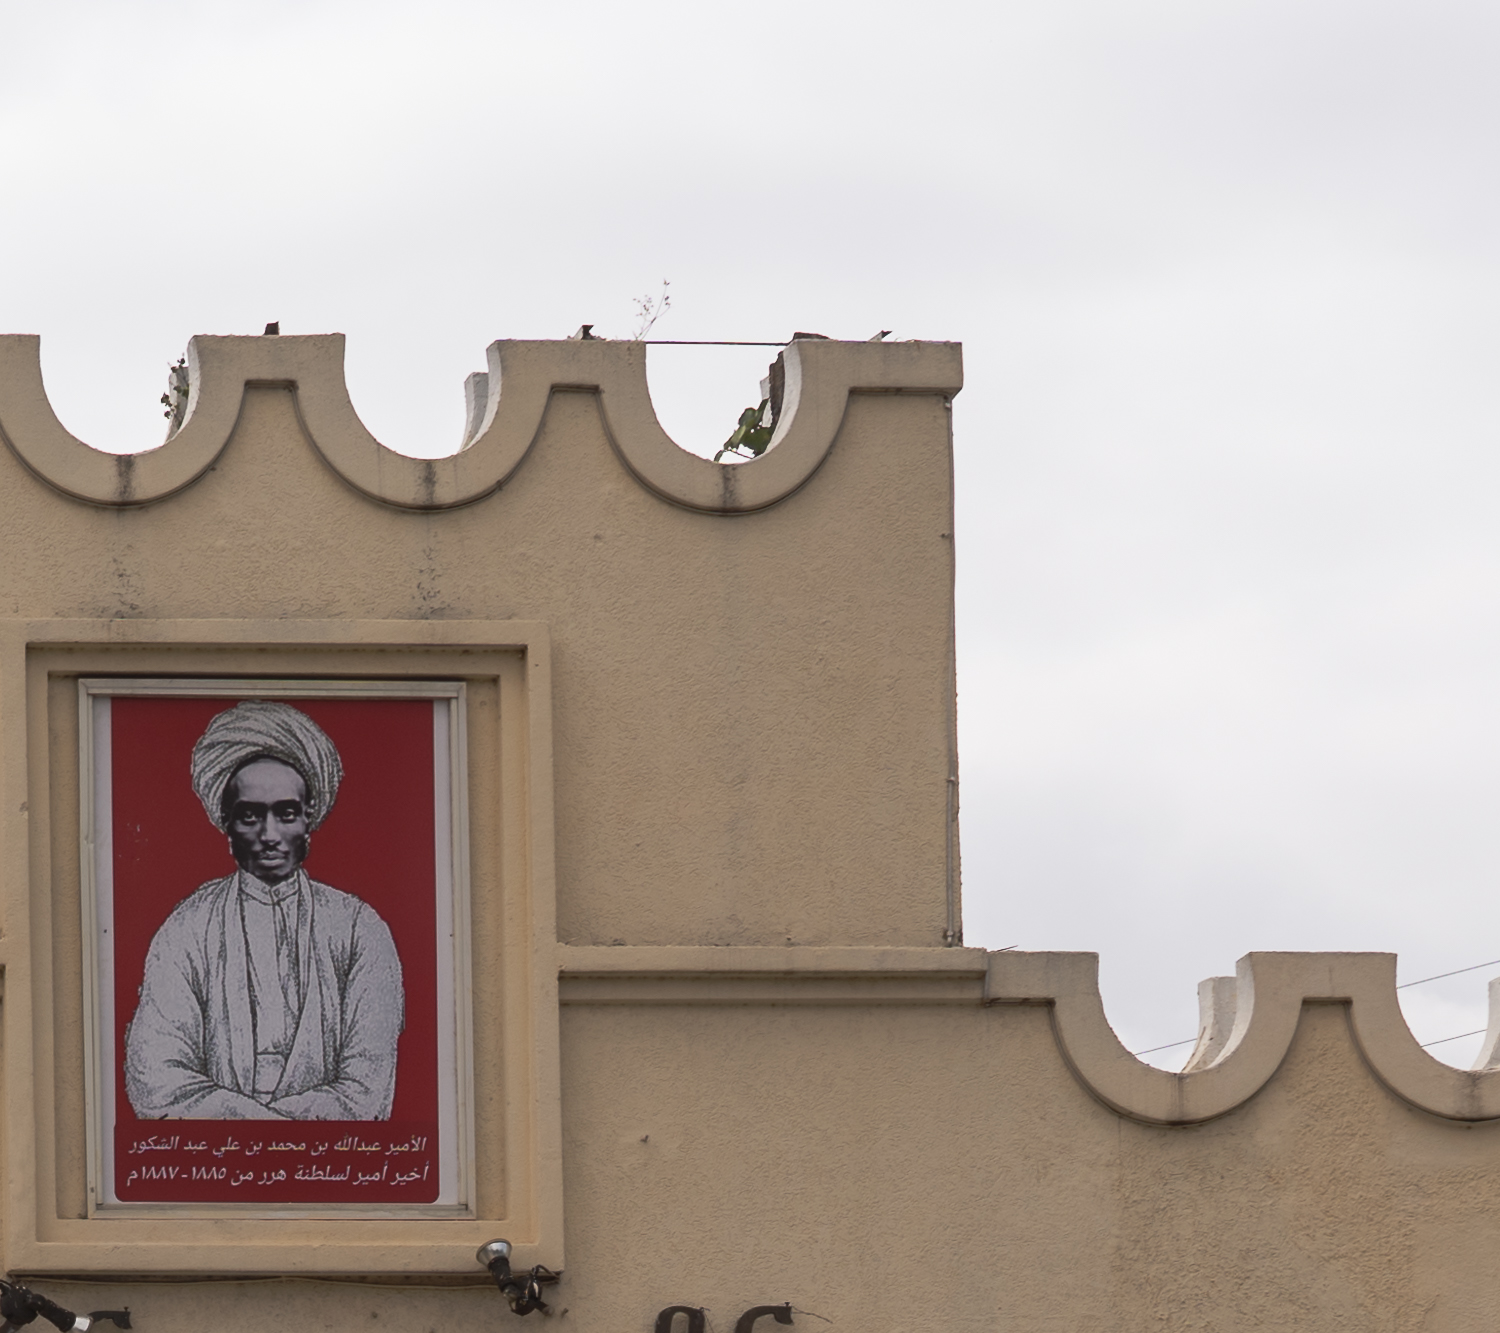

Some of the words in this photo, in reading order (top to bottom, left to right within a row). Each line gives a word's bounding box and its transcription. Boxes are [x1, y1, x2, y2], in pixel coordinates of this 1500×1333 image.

[129, 1135, 179, 1154] الشكور
[184, 1136, 208, 1151] عبد
[213, 1136, 240, 1157] علي
[245, 1140, 262, 1155] بن
[268, 1139, 306, 1152] محمد
[311, 1140, 328, 1155] بن
[385, 1135, 427, 1155] الأمير
[231, 1169, 253, 1185] من
[257, 1168, 287, 1185] هرر
[294, 1165, 350, 1181] لسلطنة
[353, 1160, 388, 1185] أمير
